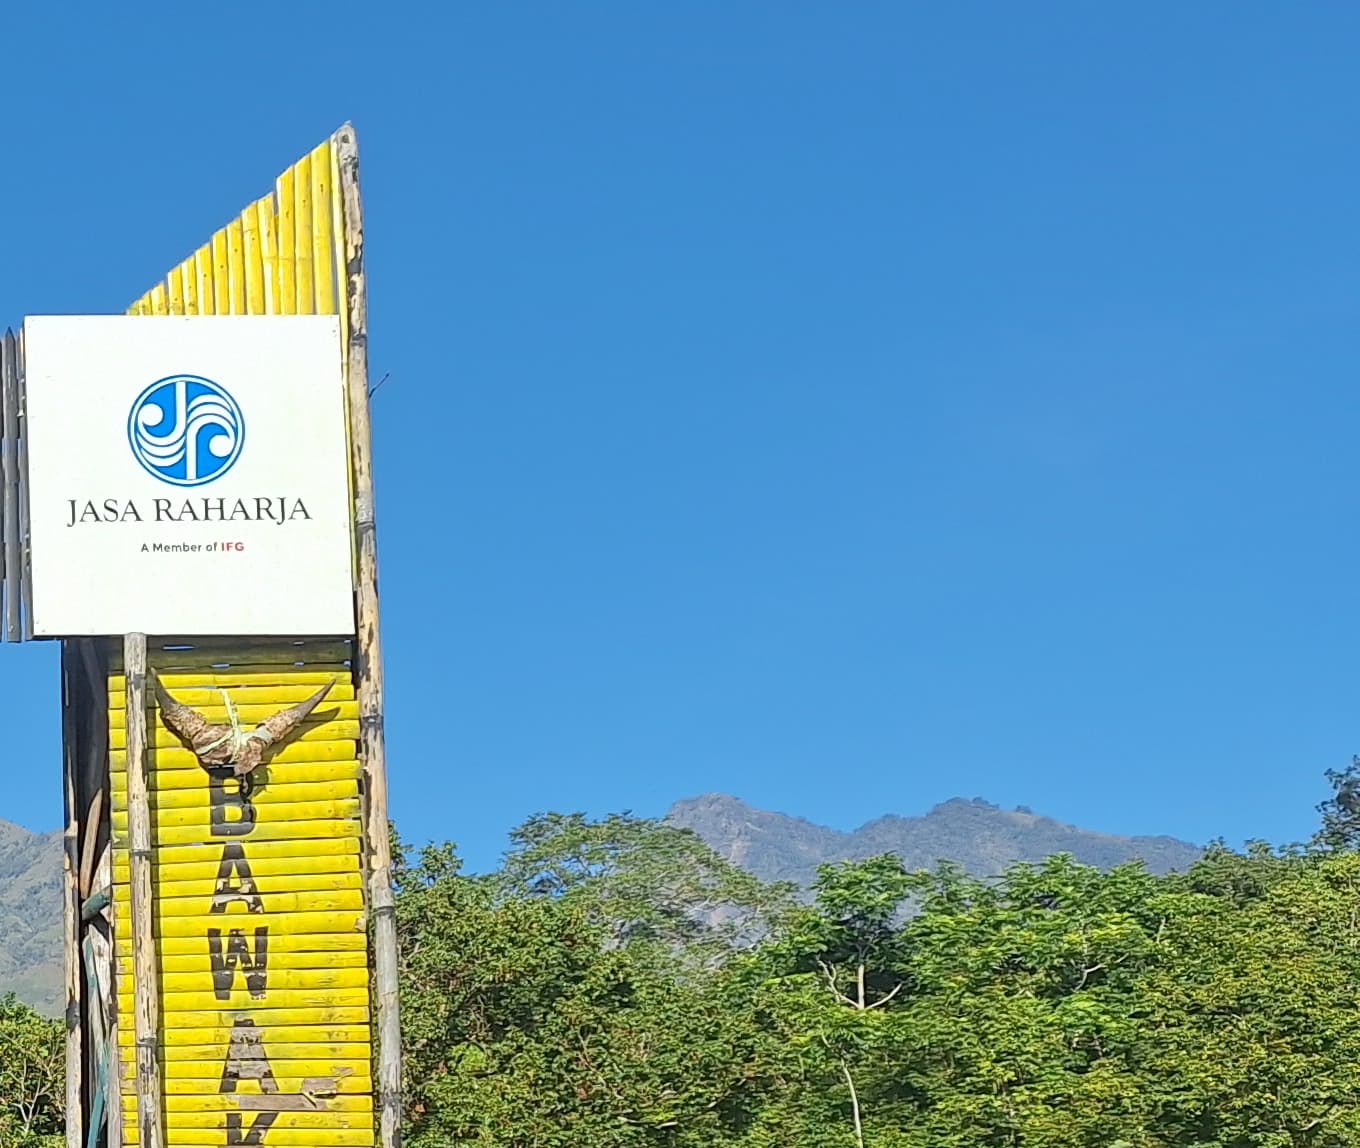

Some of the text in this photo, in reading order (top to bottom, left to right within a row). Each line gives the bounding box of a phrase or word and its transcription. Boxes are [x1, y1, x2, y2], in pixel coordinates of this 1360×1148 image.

[66, 496, 313, 527] JASA RAHARJA
[141, 541, 245, 552] A Member of IFG
